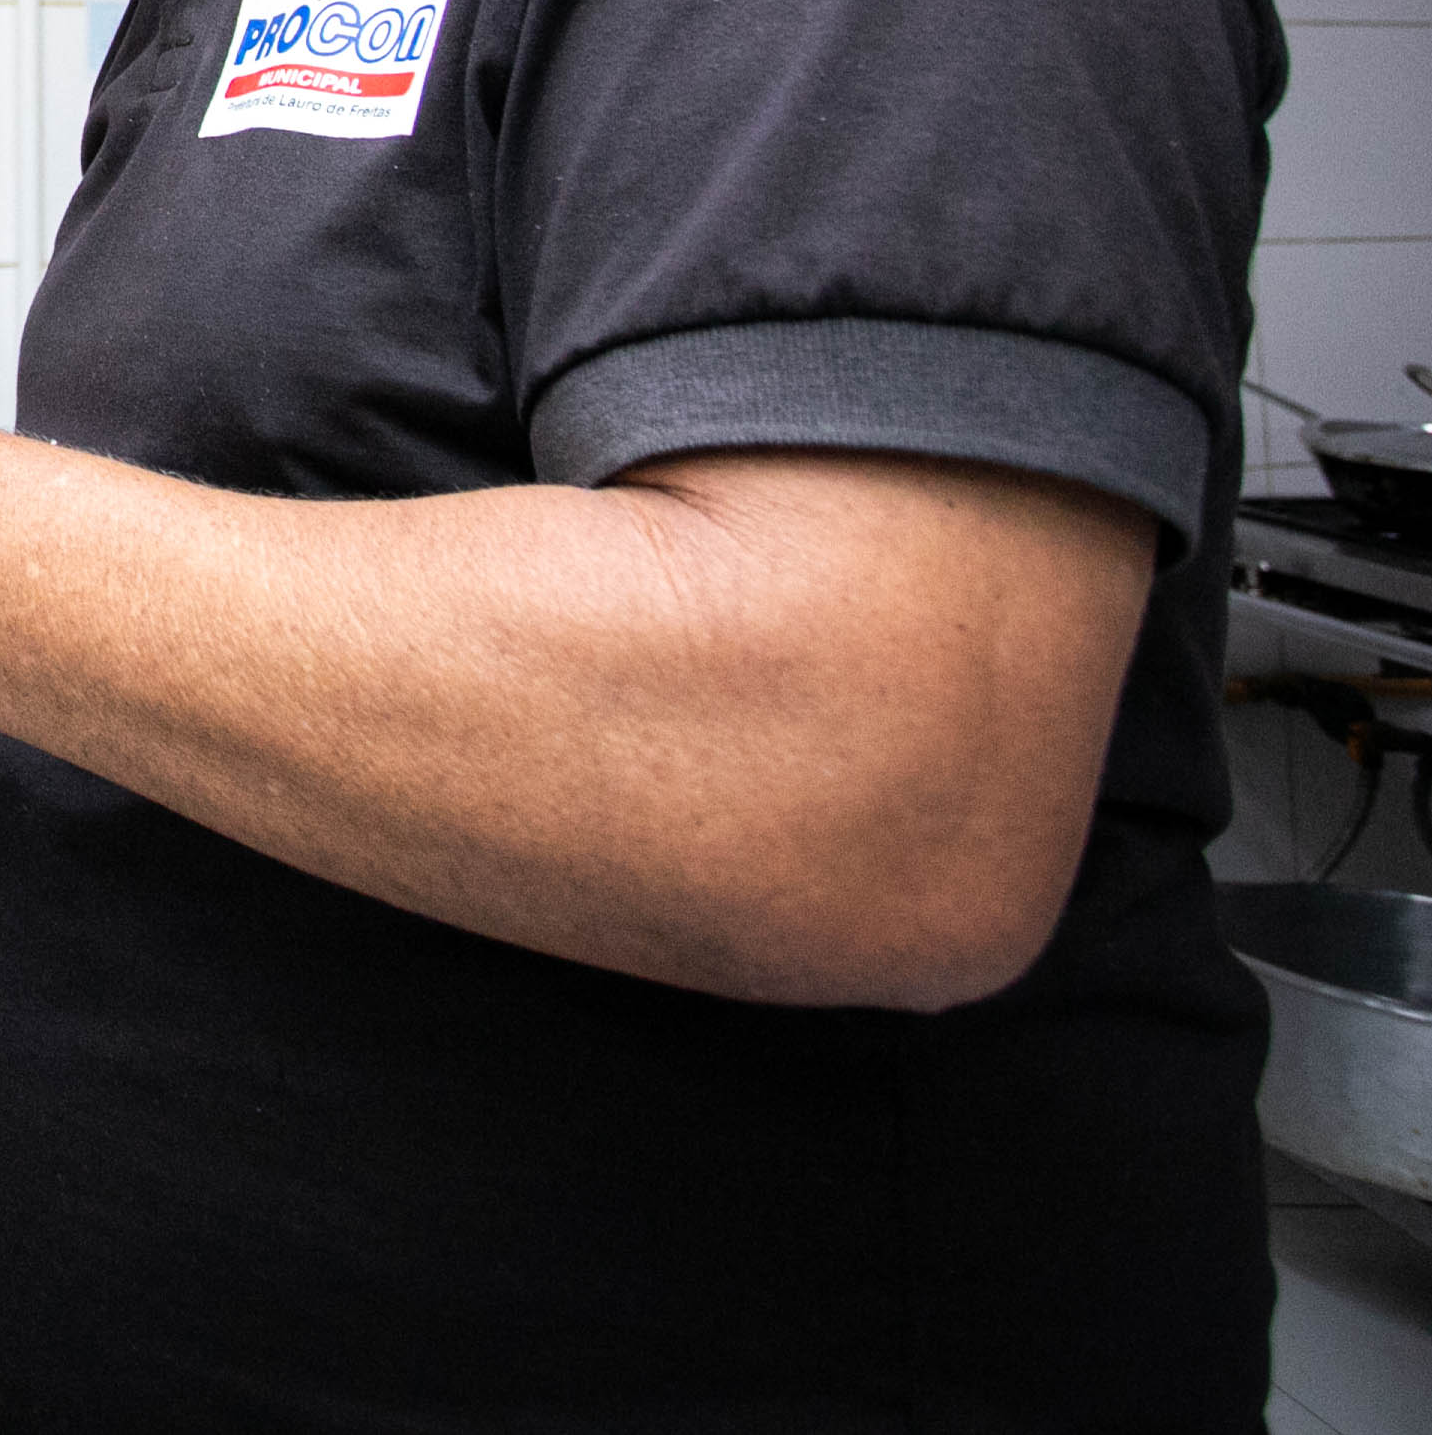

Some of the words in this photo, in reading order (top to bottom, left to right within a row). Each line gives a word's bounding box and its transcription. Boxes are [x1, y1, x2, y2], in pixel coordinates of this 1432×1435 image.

[258, 68, 363, 94] MUNICIPAL
[278, 94, 322, 112] Lauro
[326, 103, 346, 116] de
[349, 104, 392, 118] Freitas
